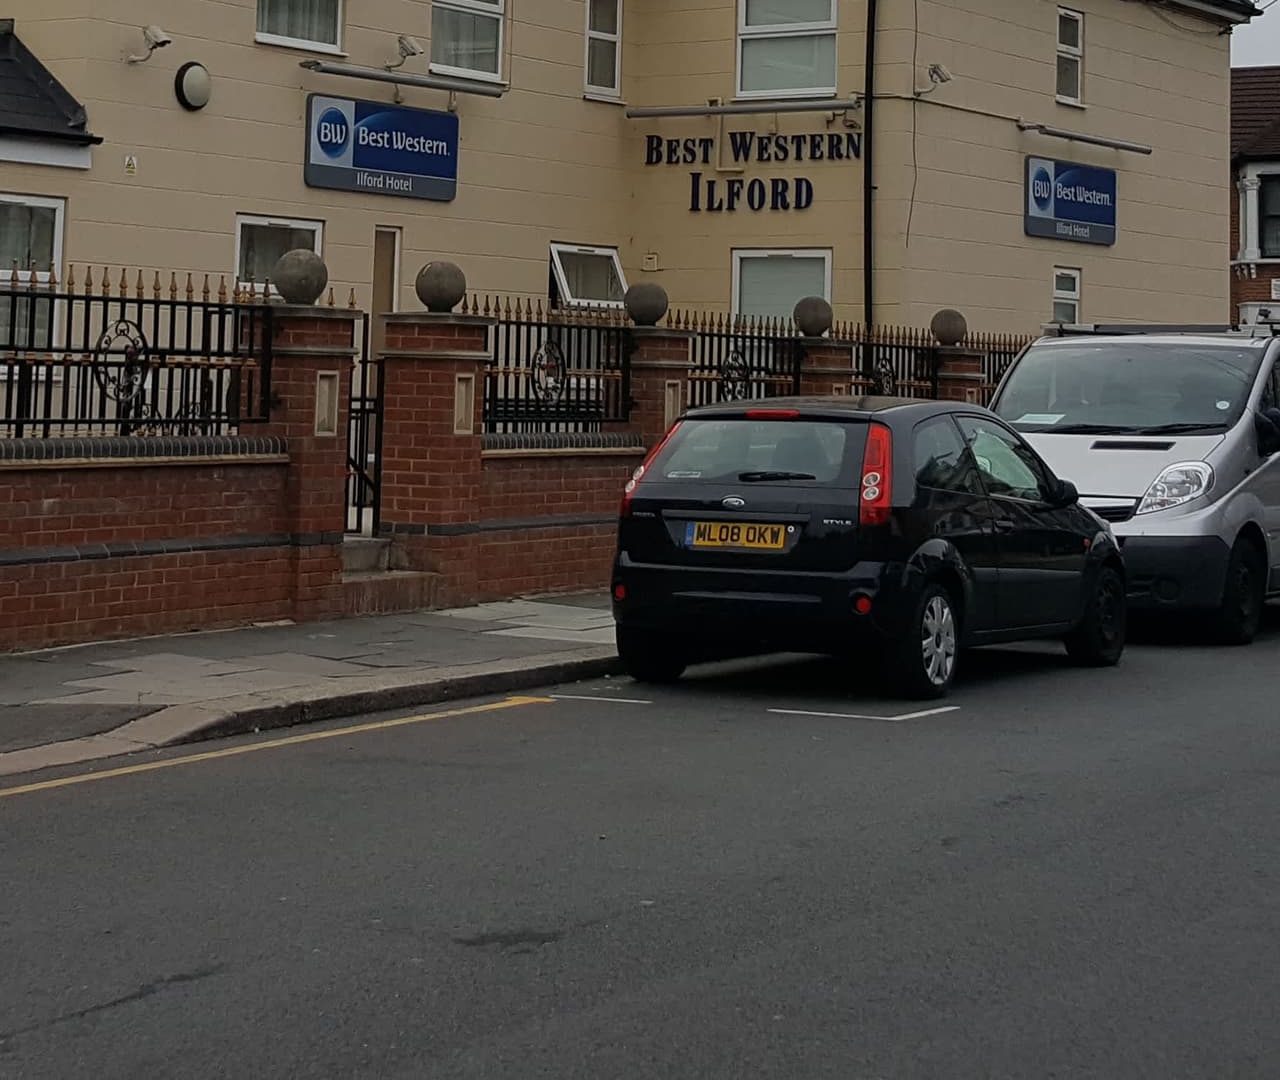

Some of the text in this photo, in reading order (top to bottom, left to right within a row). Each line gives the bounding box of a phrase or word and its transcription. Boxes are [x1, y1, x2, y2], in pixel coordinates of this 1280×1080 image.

[320, 122, 346, 143] BW
[358, 126, 447, 156] Best Western
[645, 131, 863, 166] BEST WESTERN
[356, 172, 413, 192] Ilford Hotel
[689, 172, 813, 212] ILFORD
[1034, 180, 1050, 199] BW
[1056, 182, 1111, 206] Best Western
[696, 524, 781, 544] ML08 OKW
